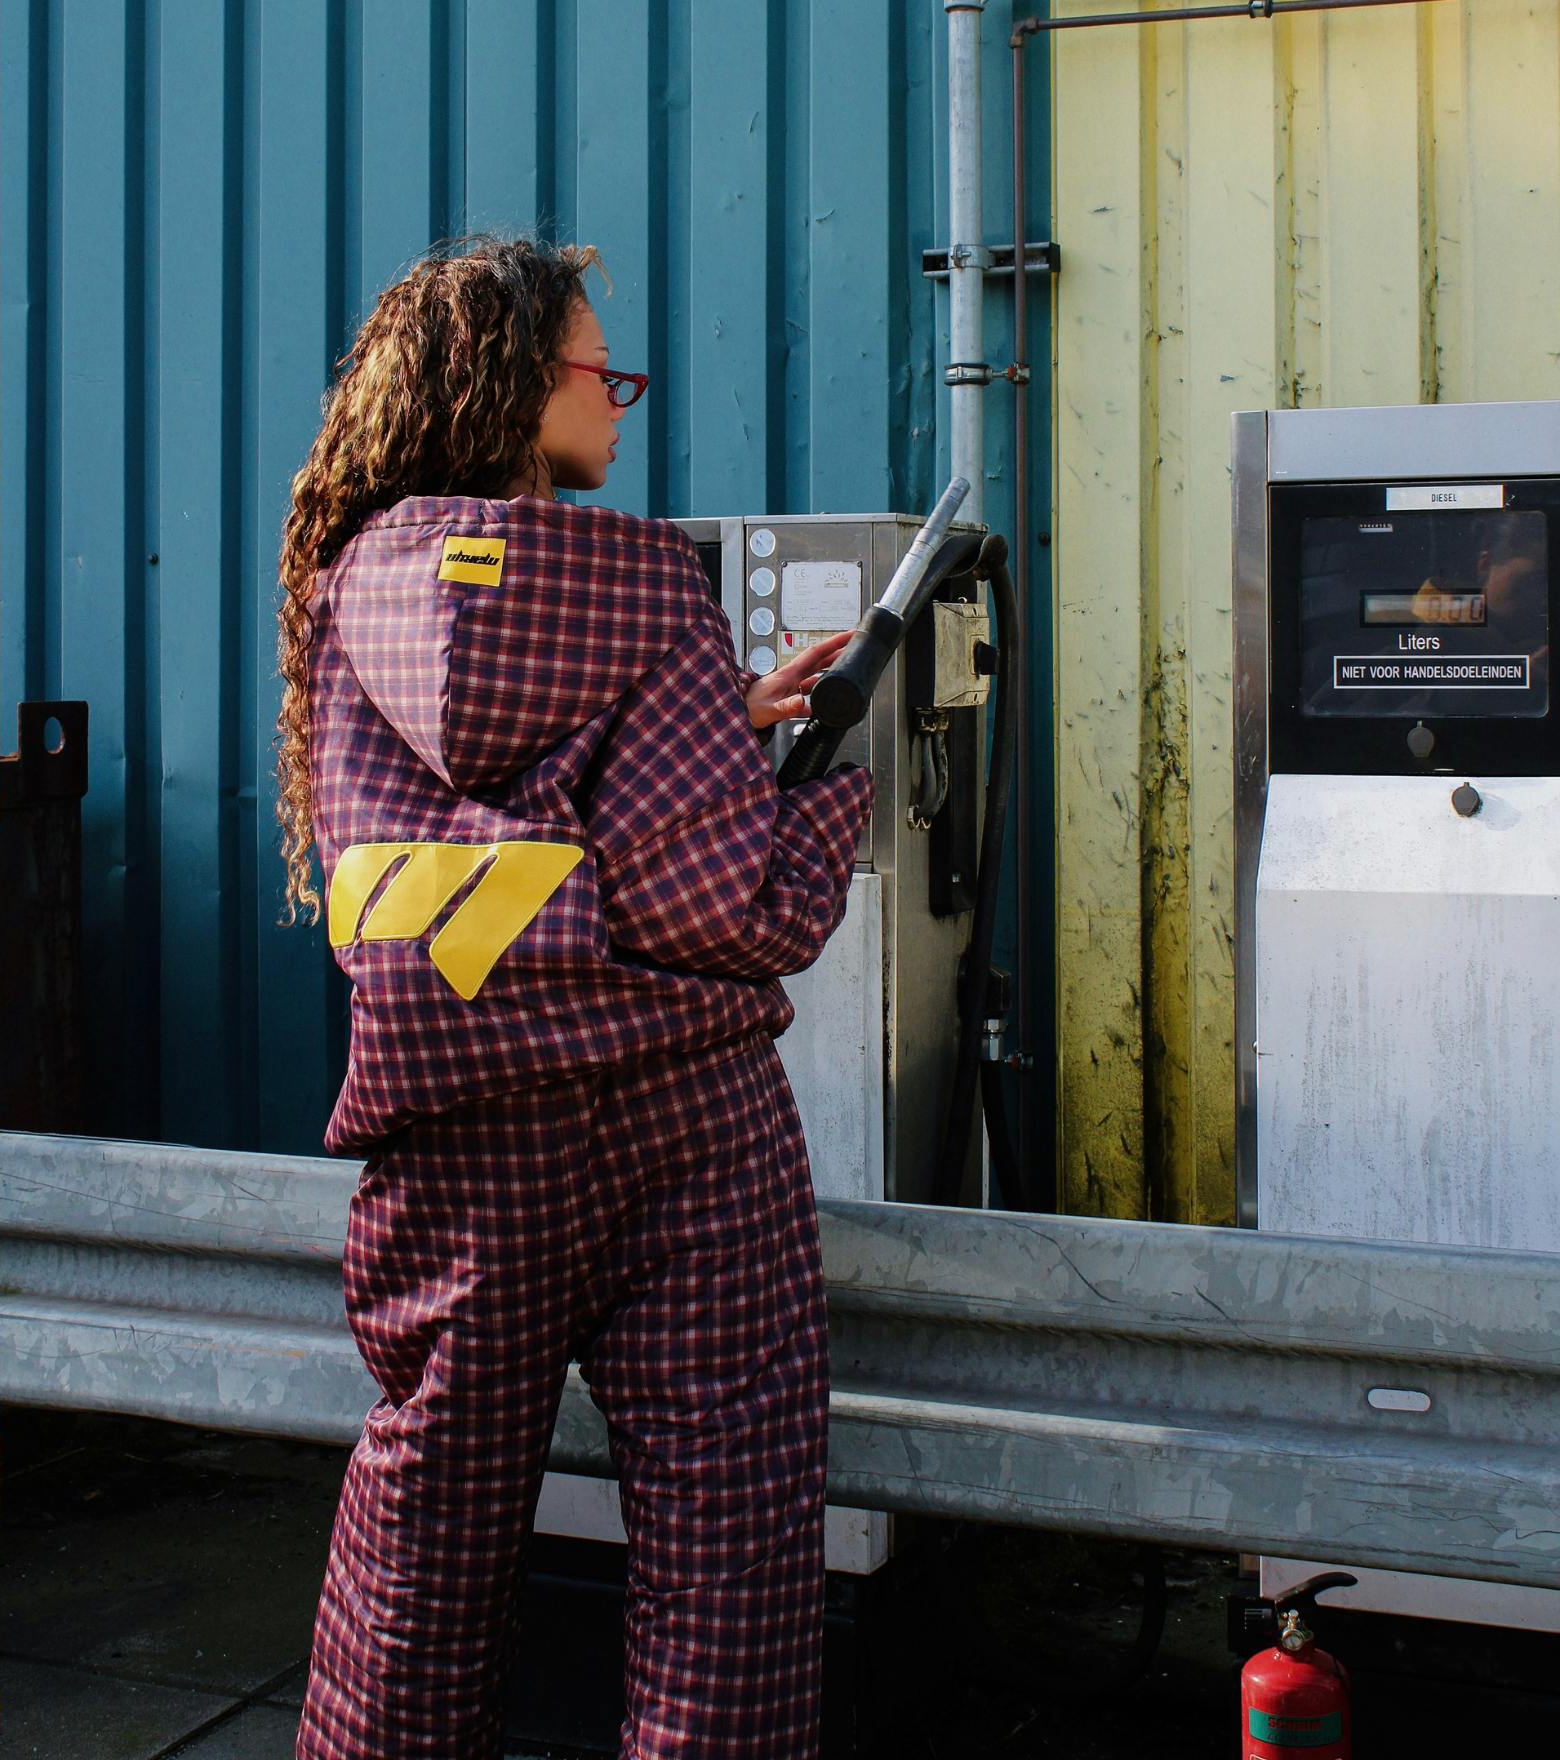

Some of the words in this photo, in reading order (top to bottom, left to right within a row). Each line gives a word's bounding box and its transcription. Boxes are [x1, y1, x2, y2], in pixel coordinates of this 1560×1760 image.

[1431, 493, 1457, 502] DIESEL
[1398, 633, 1441, 650] Liters
[1342, 666, 1366, 679] NIET
[1369, 666, 1400, 679] VOOR
[1404, 665, 1522, 679] HANDELSDOELEINDEN
[1268, 1717, 1321, 1731] SCHUIM
